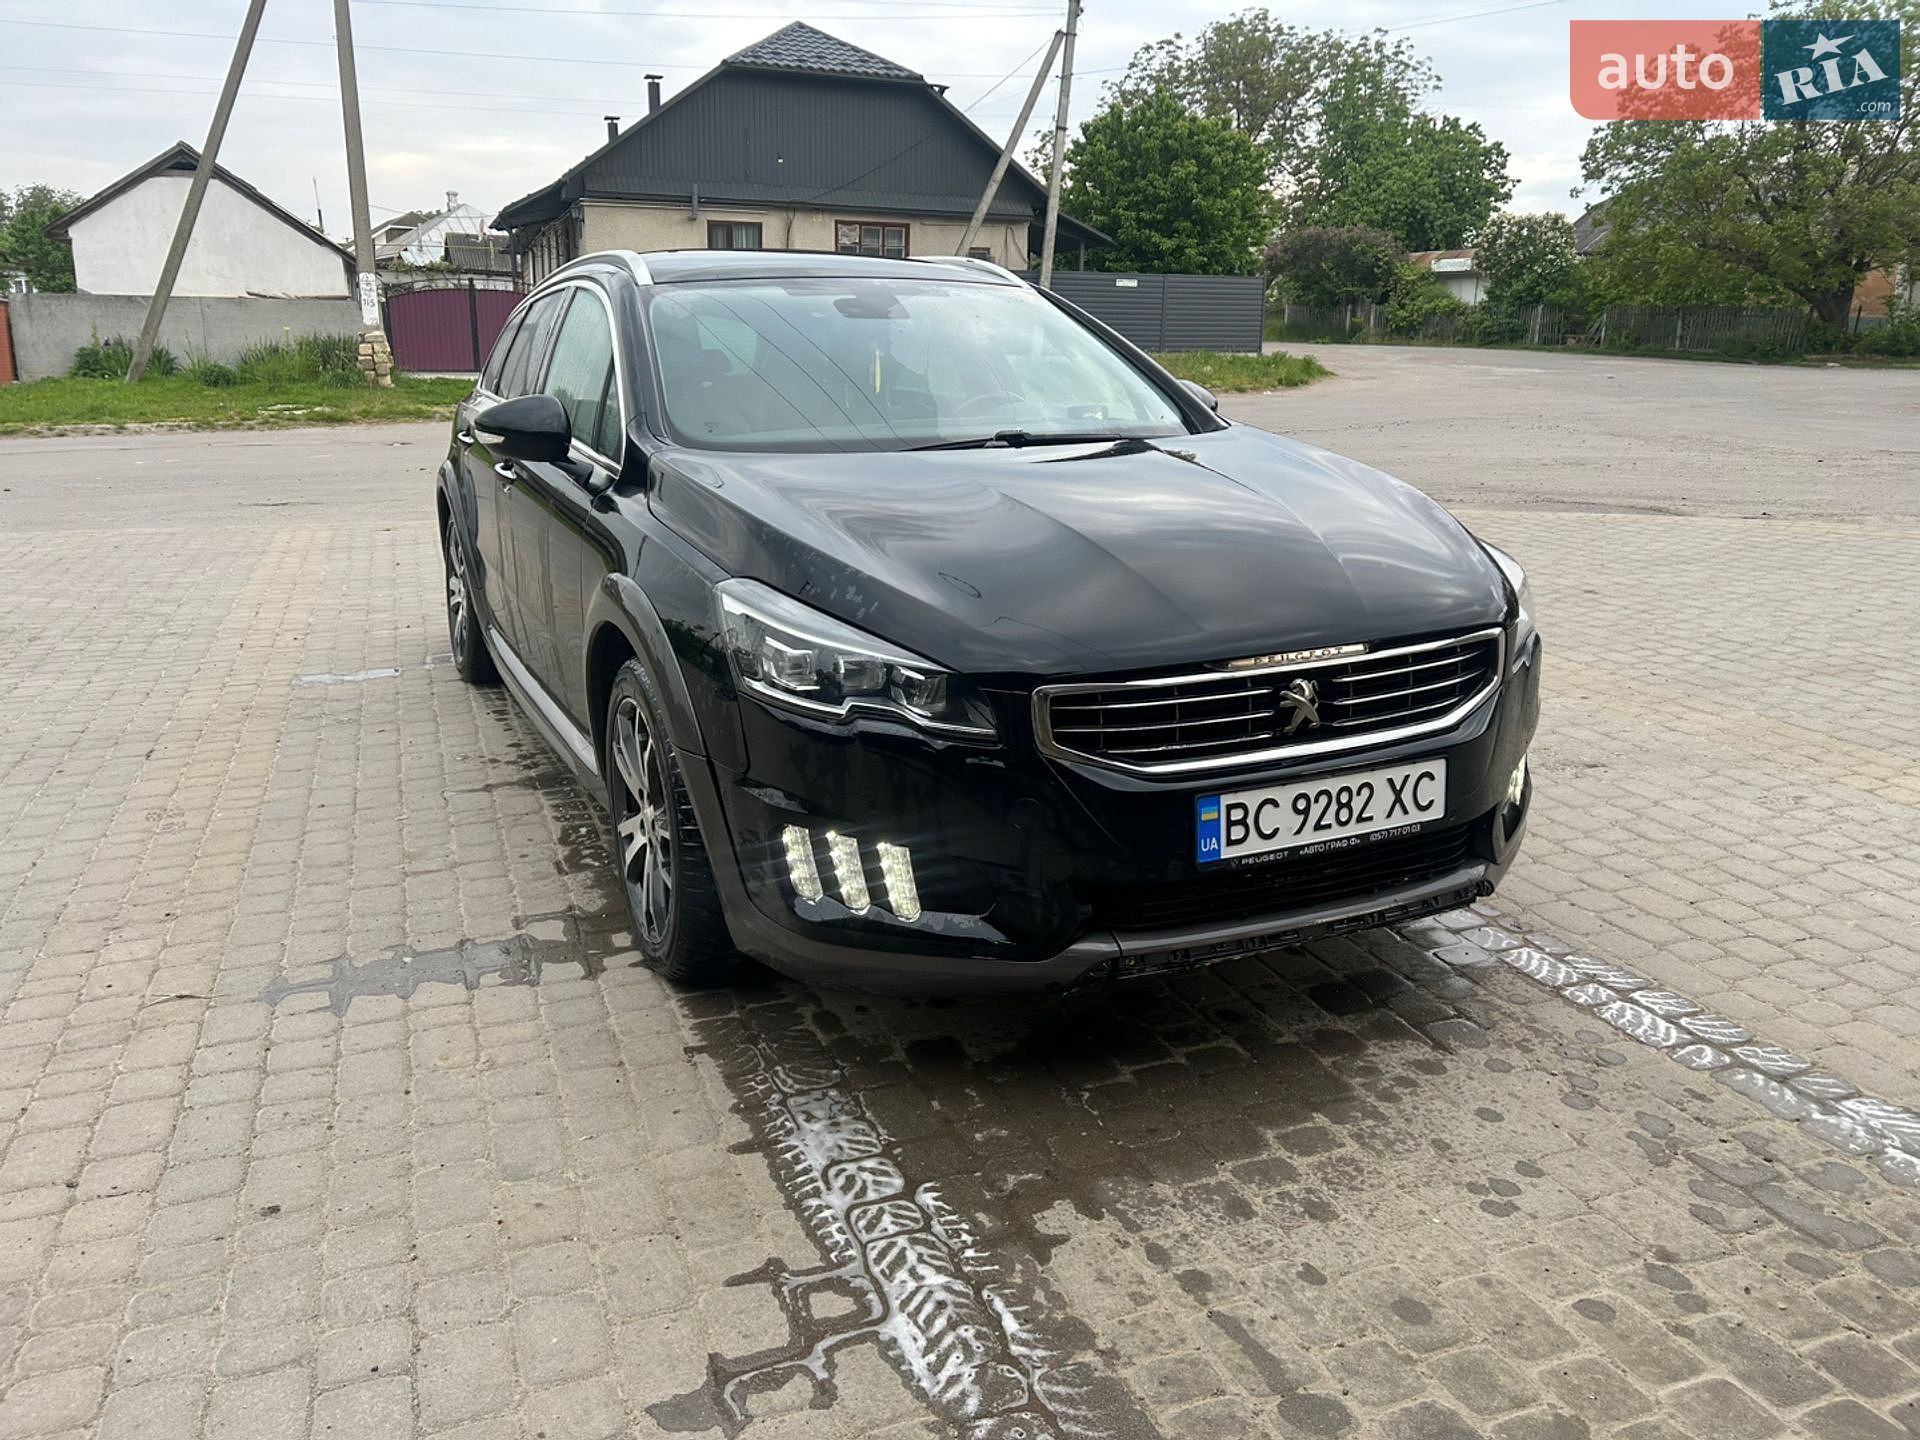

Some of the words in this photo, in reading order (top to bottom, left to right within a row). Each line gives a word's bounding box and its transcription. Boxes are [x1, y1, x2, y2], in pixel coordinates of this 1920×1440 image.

[1225, 797, 1281, 848] BC
[1291, 781, 1375, 836] 9282
[1386, 770, 1436, 819] XC
[1201, 836, 1219, 852] UA
[1241, 850, 1289, 865] PEUGEOT
